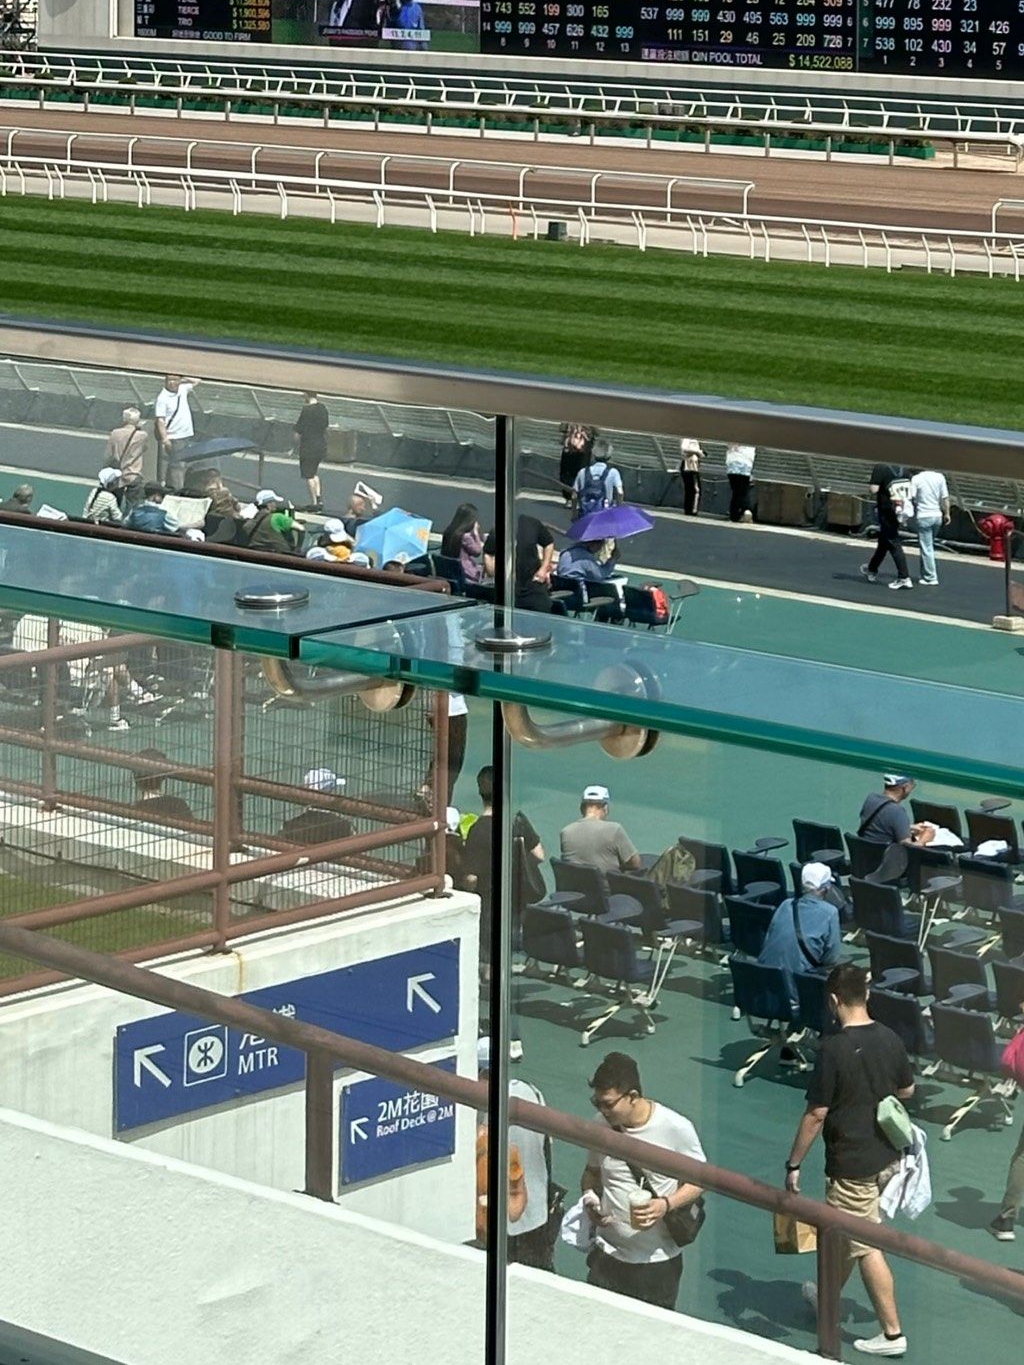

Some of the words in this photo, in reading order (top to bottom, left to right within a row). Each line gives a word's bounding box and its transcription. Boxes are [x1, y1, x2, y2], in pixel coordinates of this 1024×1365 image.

[709, 52, 734, 63] POOL
[735, 53, 763, 65] TOTAL
[789, 55, 795, 67] $
[238, 1047, 278, 1075] MTR
[376, 1119, 400, 1138] Roof
[401, 1113, 426, 1131] Deck
[427, 1109, 437, 1123] @
[437, 1104, 454, 1121] 2M
